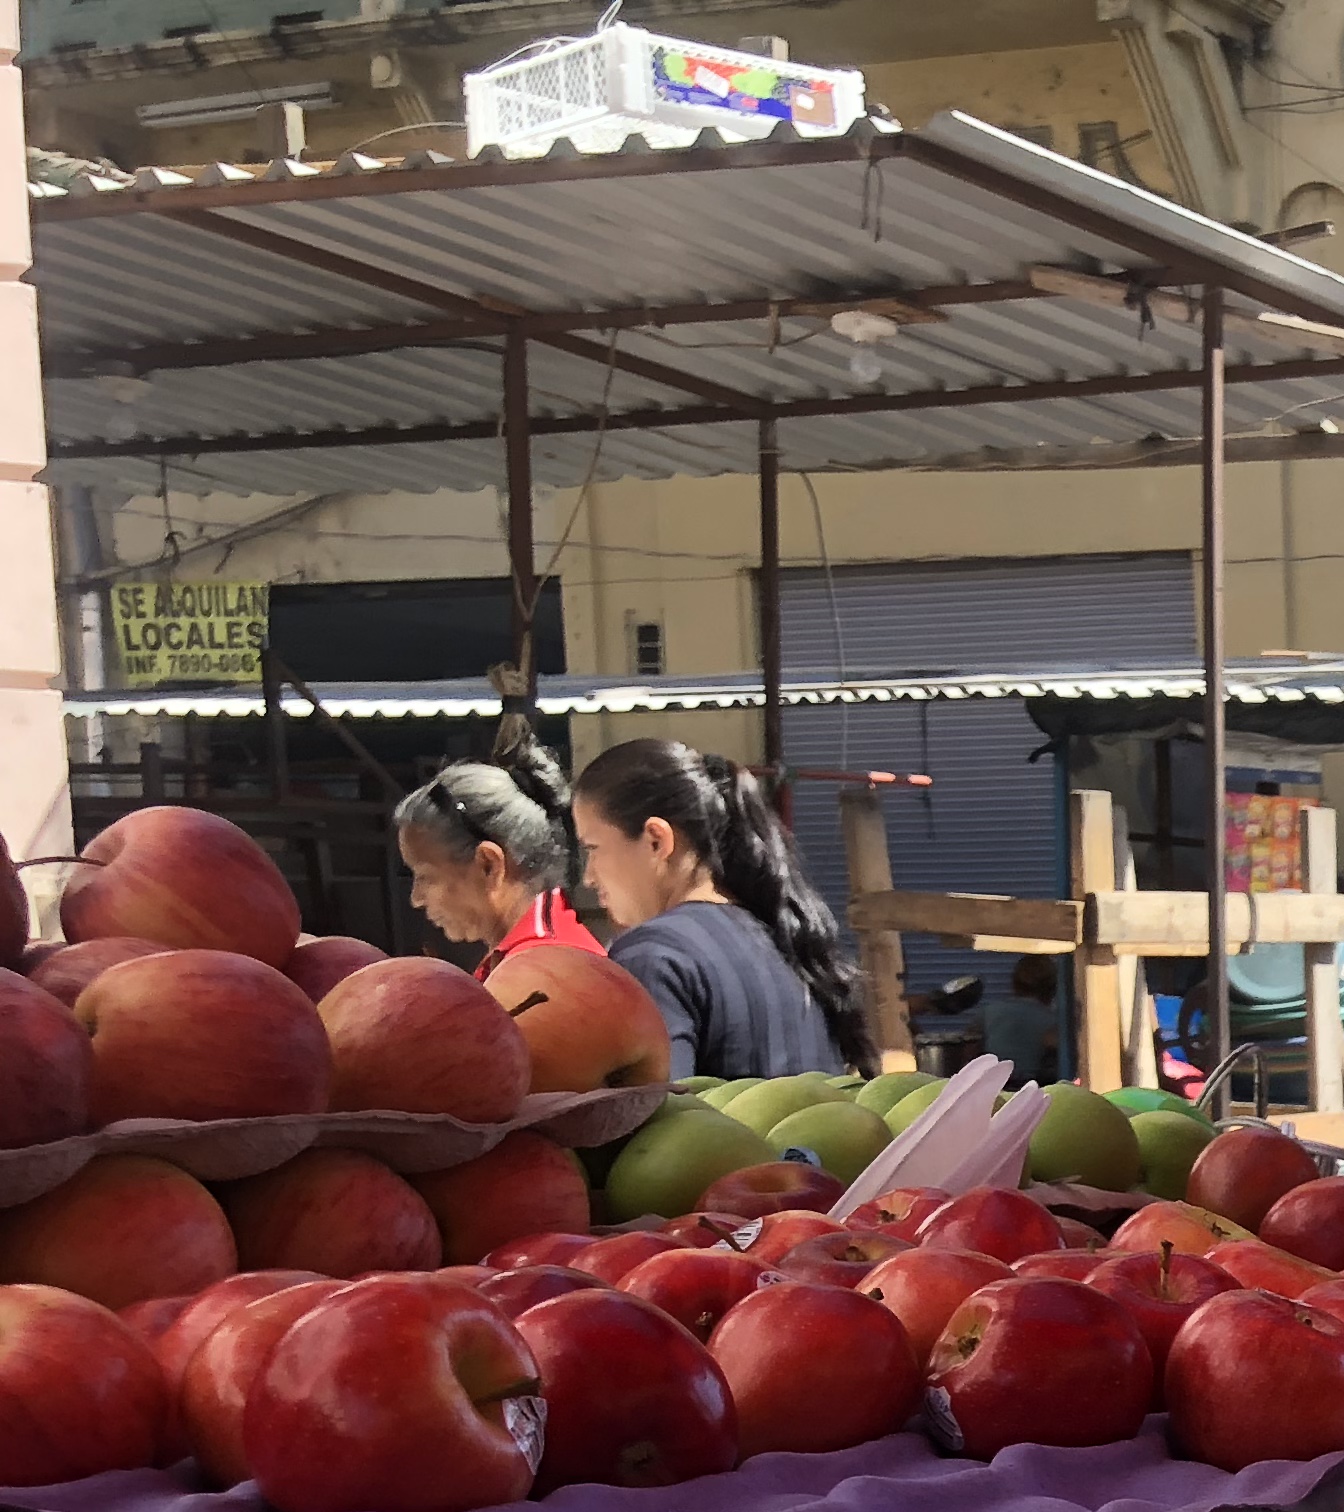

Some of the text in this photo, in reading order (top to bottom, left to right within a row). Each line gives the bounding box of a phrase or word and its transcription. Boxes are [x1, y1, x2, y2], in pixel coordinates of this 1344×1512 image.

[118, 584, 270, 620] SE ALQUILAN
[122, 621, 267, 651] LOCALES
